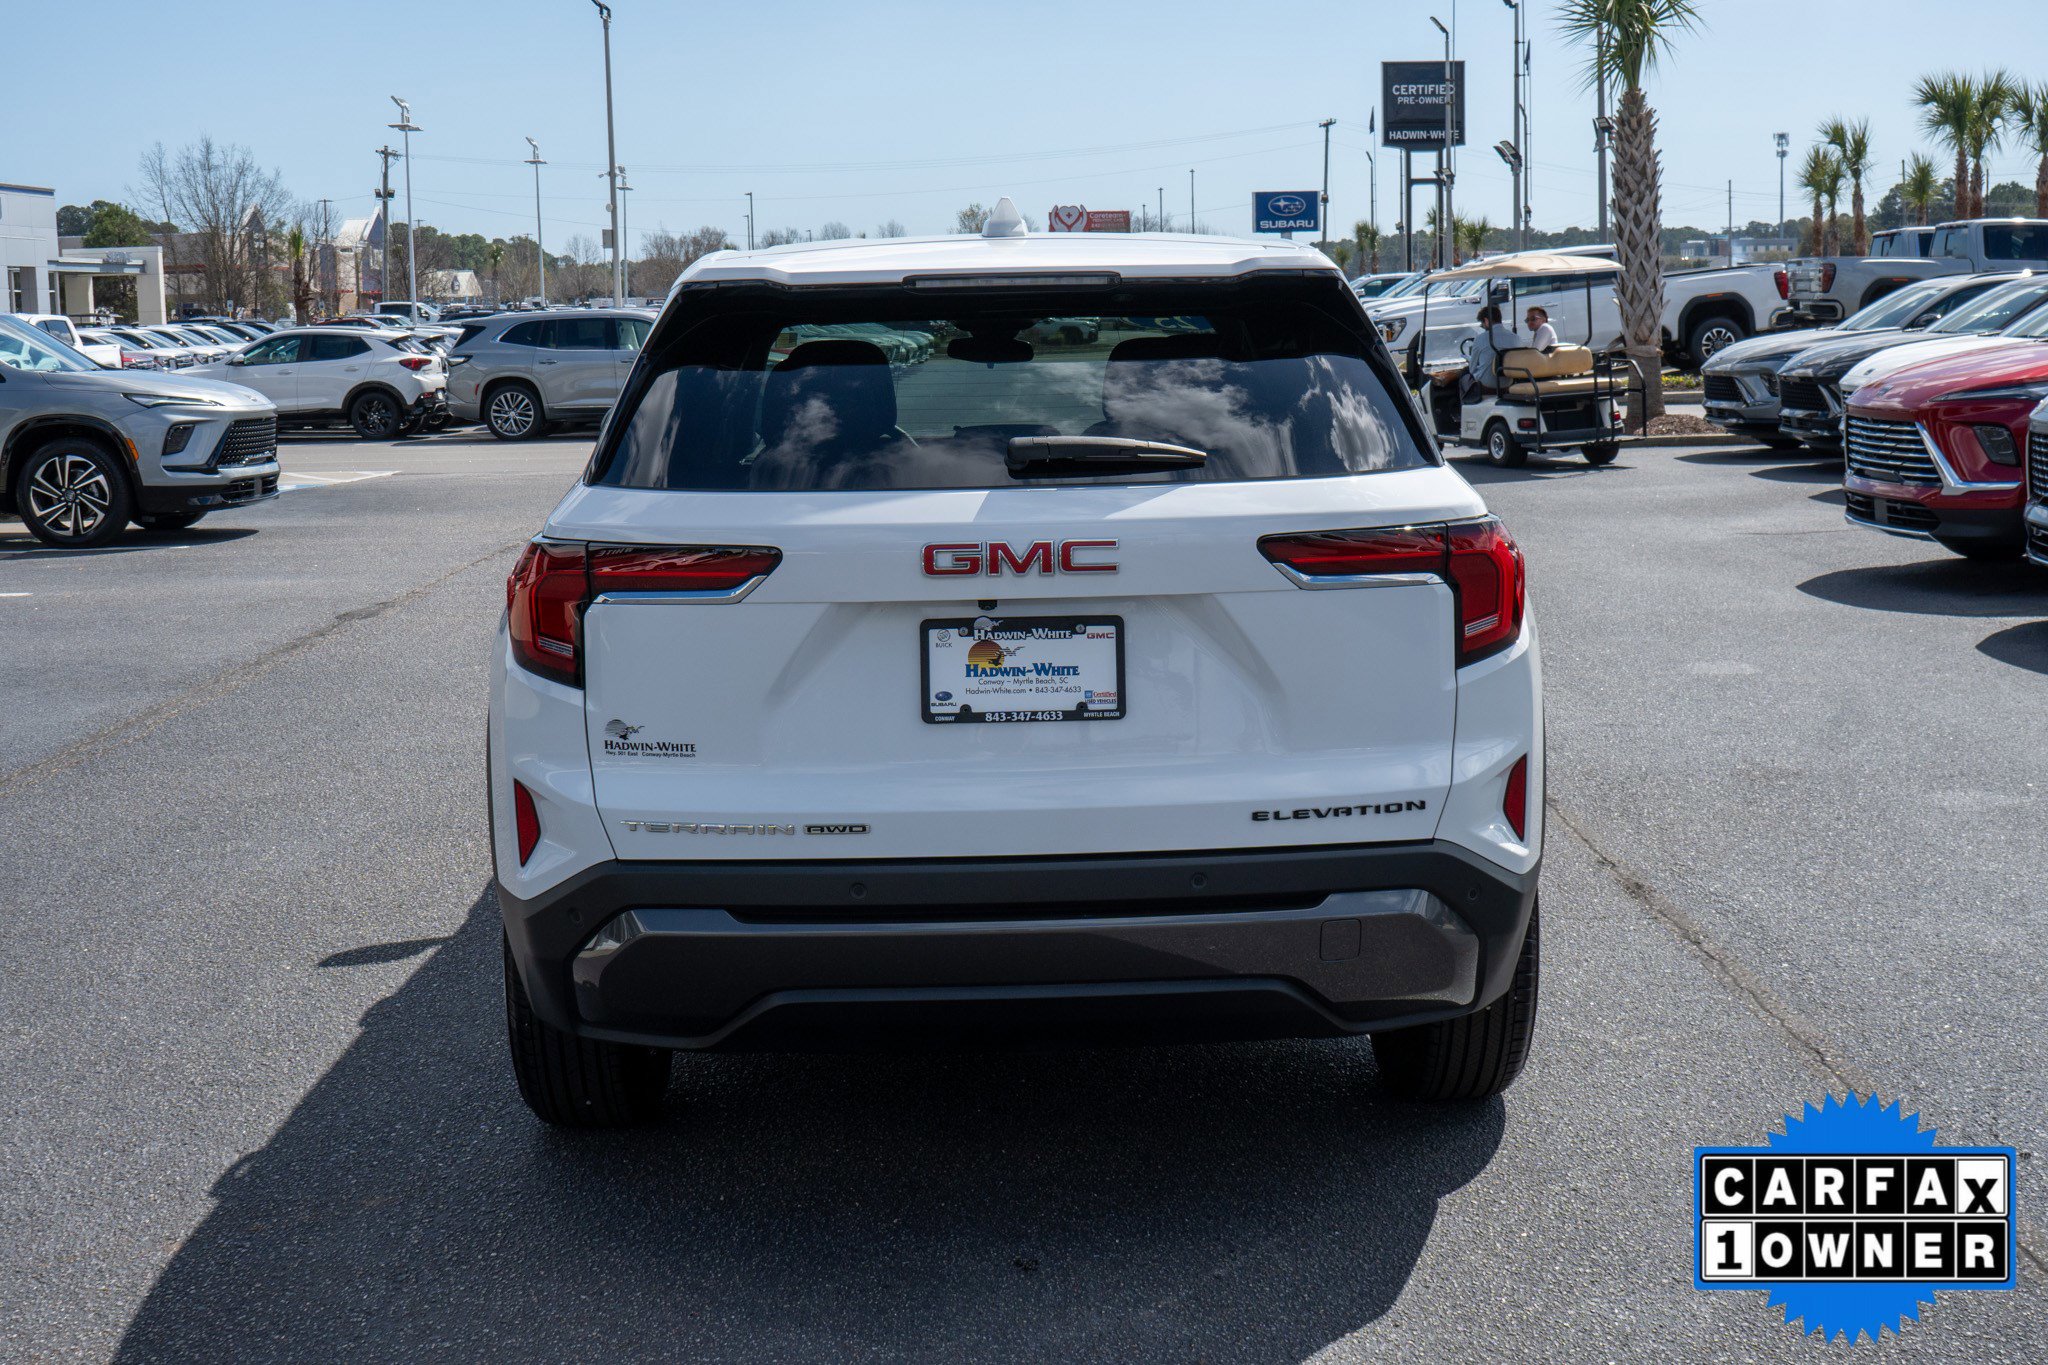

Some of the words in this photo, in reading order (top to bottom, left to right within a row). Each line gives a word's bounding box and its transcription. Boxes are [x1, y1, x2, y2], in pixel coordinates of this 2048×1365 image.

[1392, 84, 1455, 95] CERTIFIED
[1397, 96, 1448, 105] PRE-OWNE
[1389, 130, 1460, 140] HADWIN-WHTE
[1260, 220, 1315, 229] SUBARU
[921, 539, 1119, 576] GMC
[978, 678, 1005, 686] Conway
[1013, 677, 1034, 686] Myrtle
[1036, 677, 1057, 685] Beach,
[965, 687, 1026, 695] Hadwin-White.com
[1035, 686, 1082, 694] 843-347-4633
[985, 711, 1063, 722] 843-347-4633
[604, 740, 697, 753] HADWIN-WHITE
[1252, 800, 1426, 821] ELEVATION
[620, 820, 795, 836] TERRAIN
[804, 824, 870, 834] AWD
